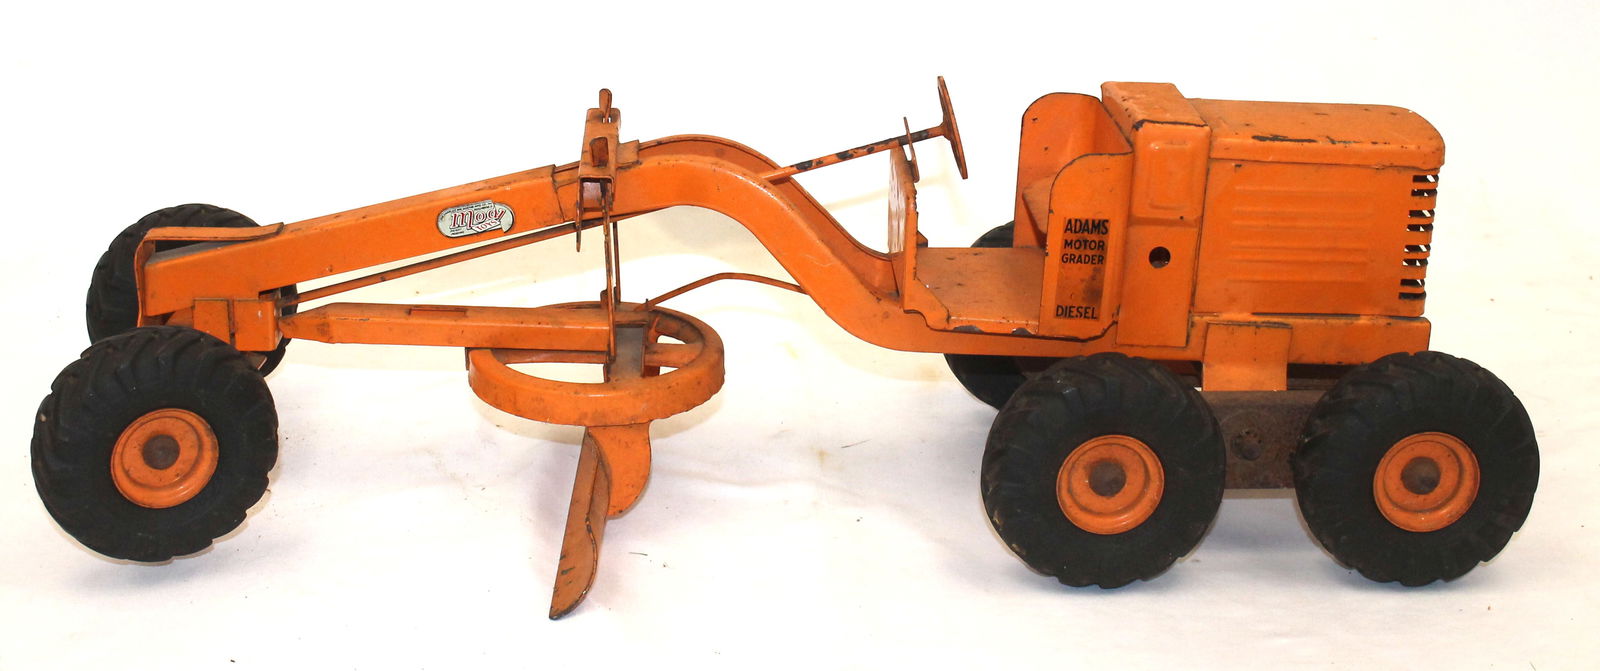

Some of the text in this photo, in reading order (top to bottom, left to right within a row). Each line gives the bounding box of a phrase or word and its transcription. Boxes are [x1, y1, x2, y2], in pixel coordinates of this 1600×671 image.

[1063, 218, 1109, 235] ADAMS
[1063, 239, 1105, 251] MOTOR
[1061, 253, 1105, 265] GRADER
[1055, 304, 1098, 320] DIESEL
